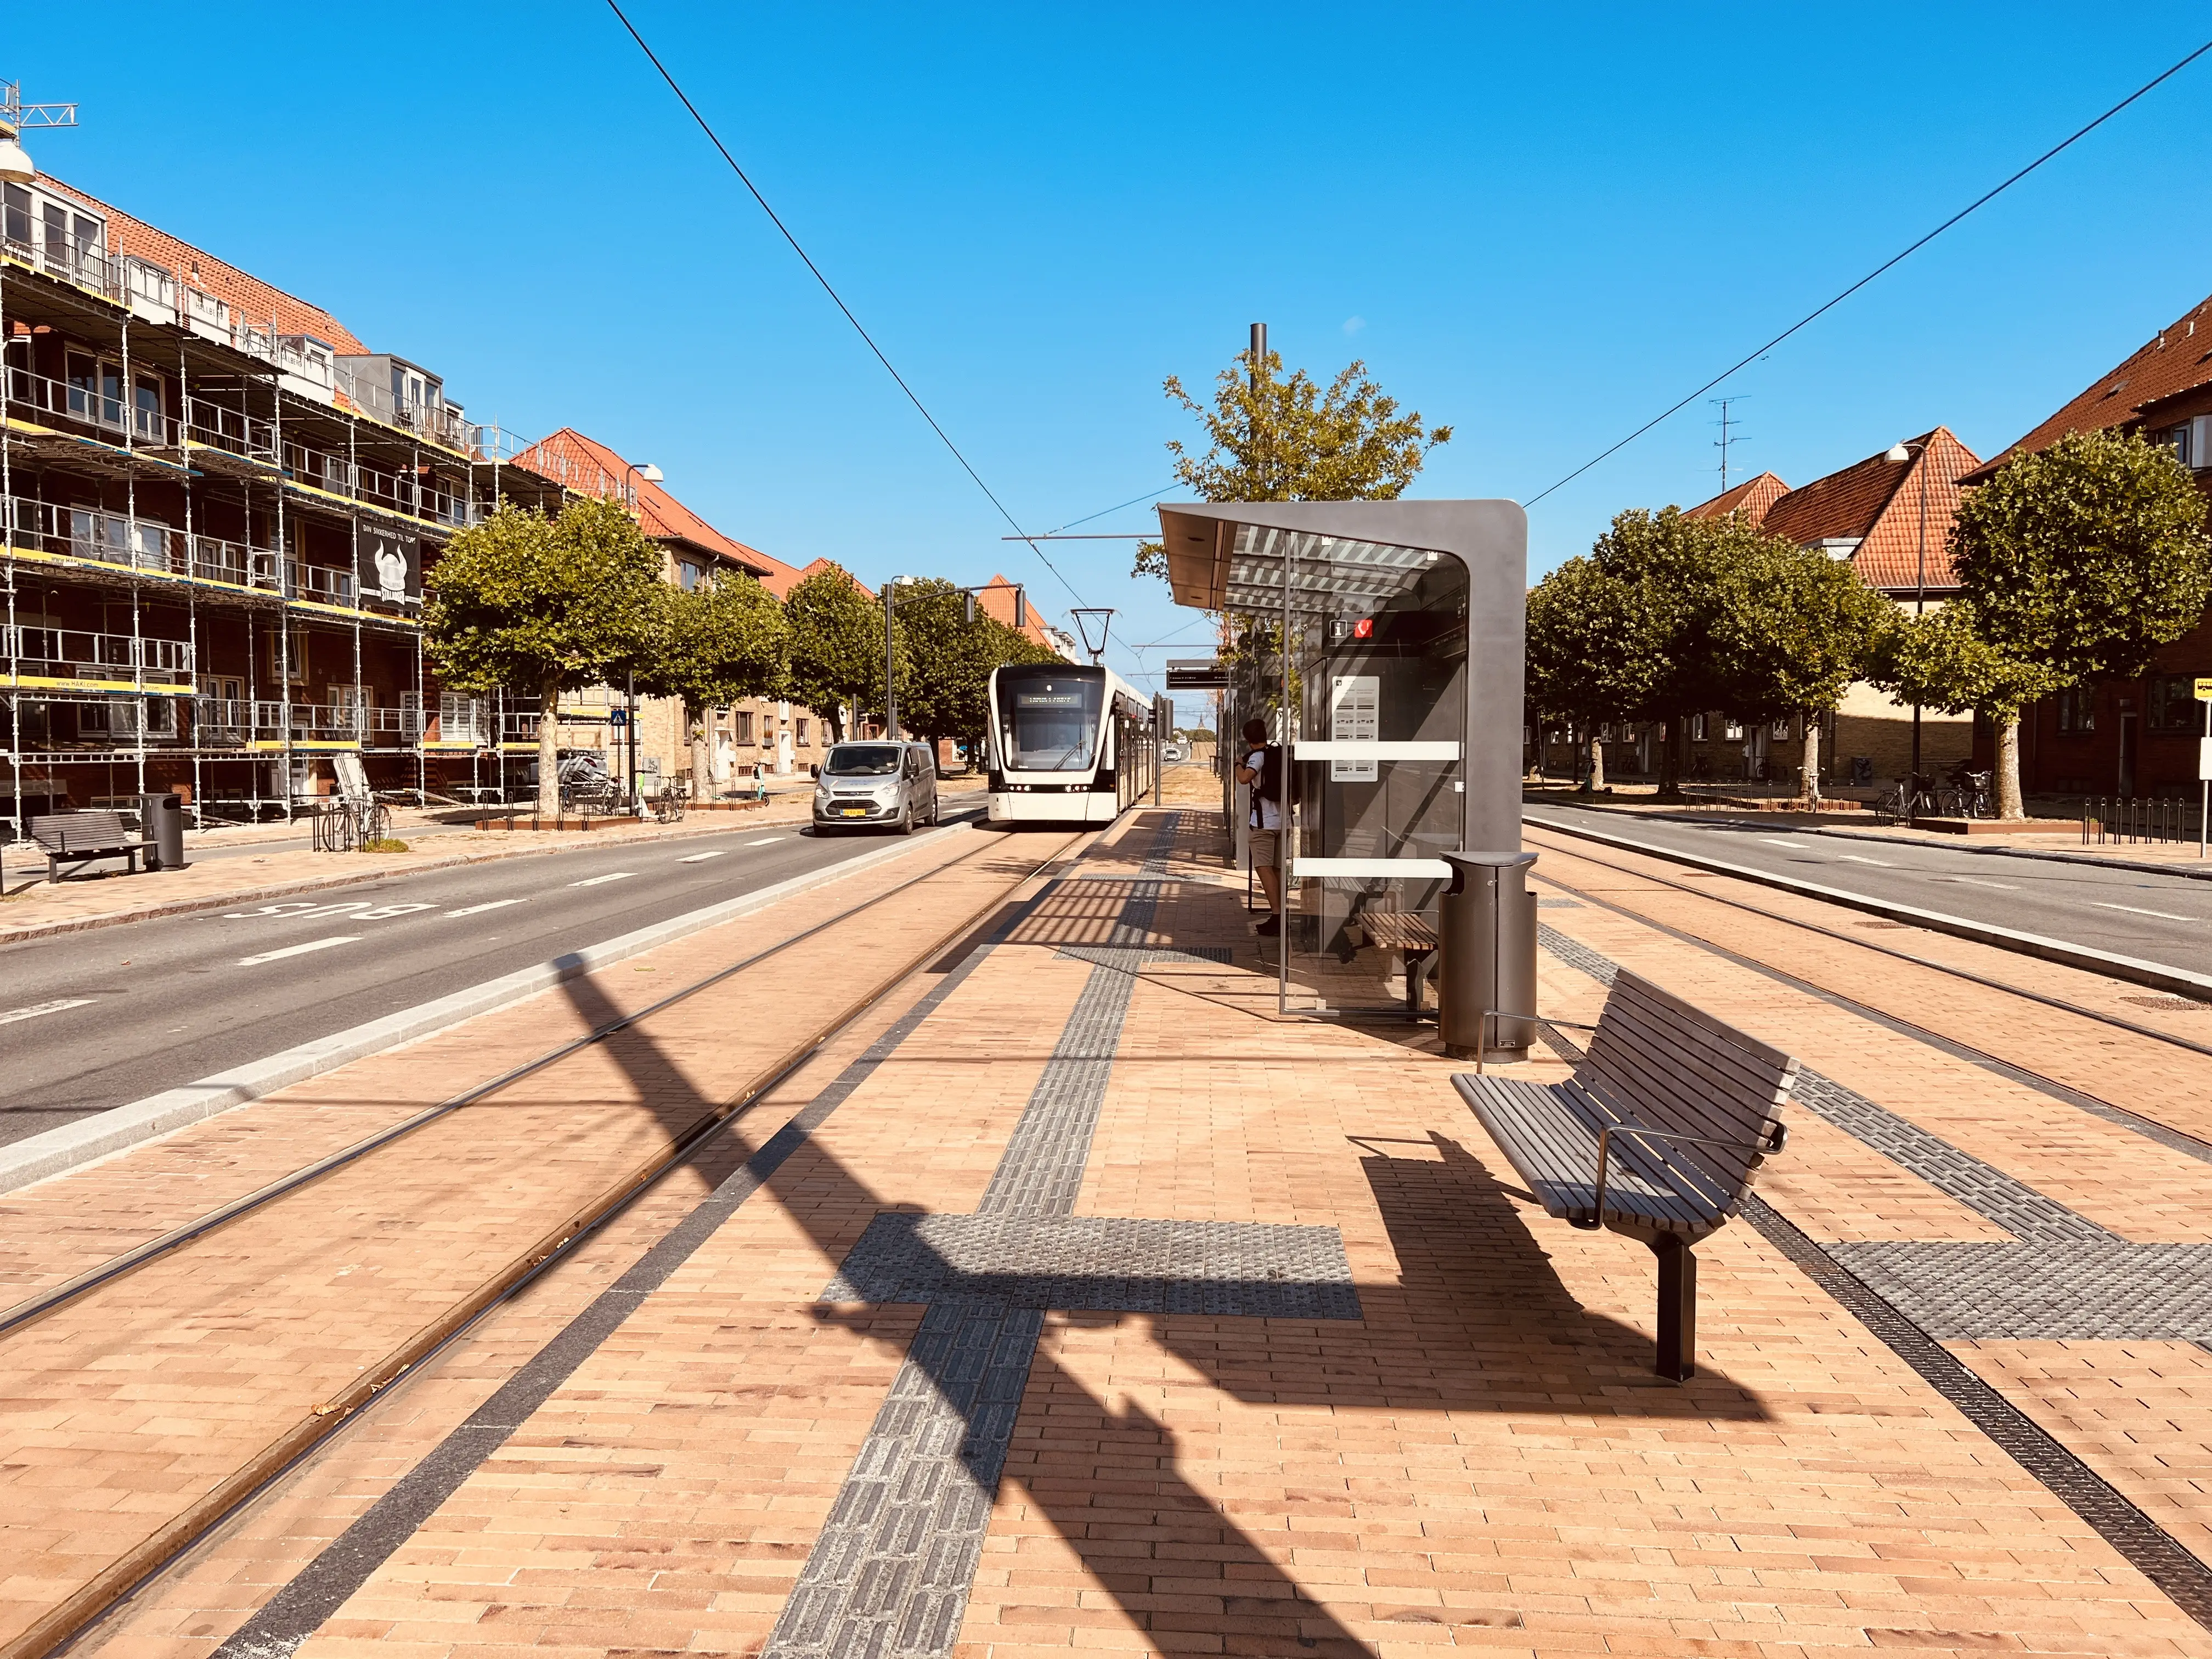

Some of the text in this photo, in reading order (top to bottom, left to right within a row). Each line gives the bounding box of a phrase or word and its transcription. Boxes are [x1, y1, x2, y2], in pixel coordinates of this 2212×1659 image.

[195, 302, 223, 320] HALLBEG
[281, 354, 302, 368] ALLBERG
[363, 524, 372, 533] DIN
[373, 527, 397, 540] SIKKERHED
[405, 535, 416, 544] TOPS
[383, 579, 402, 589] HALLBERG
[223, 901, 441, 920] BUS
